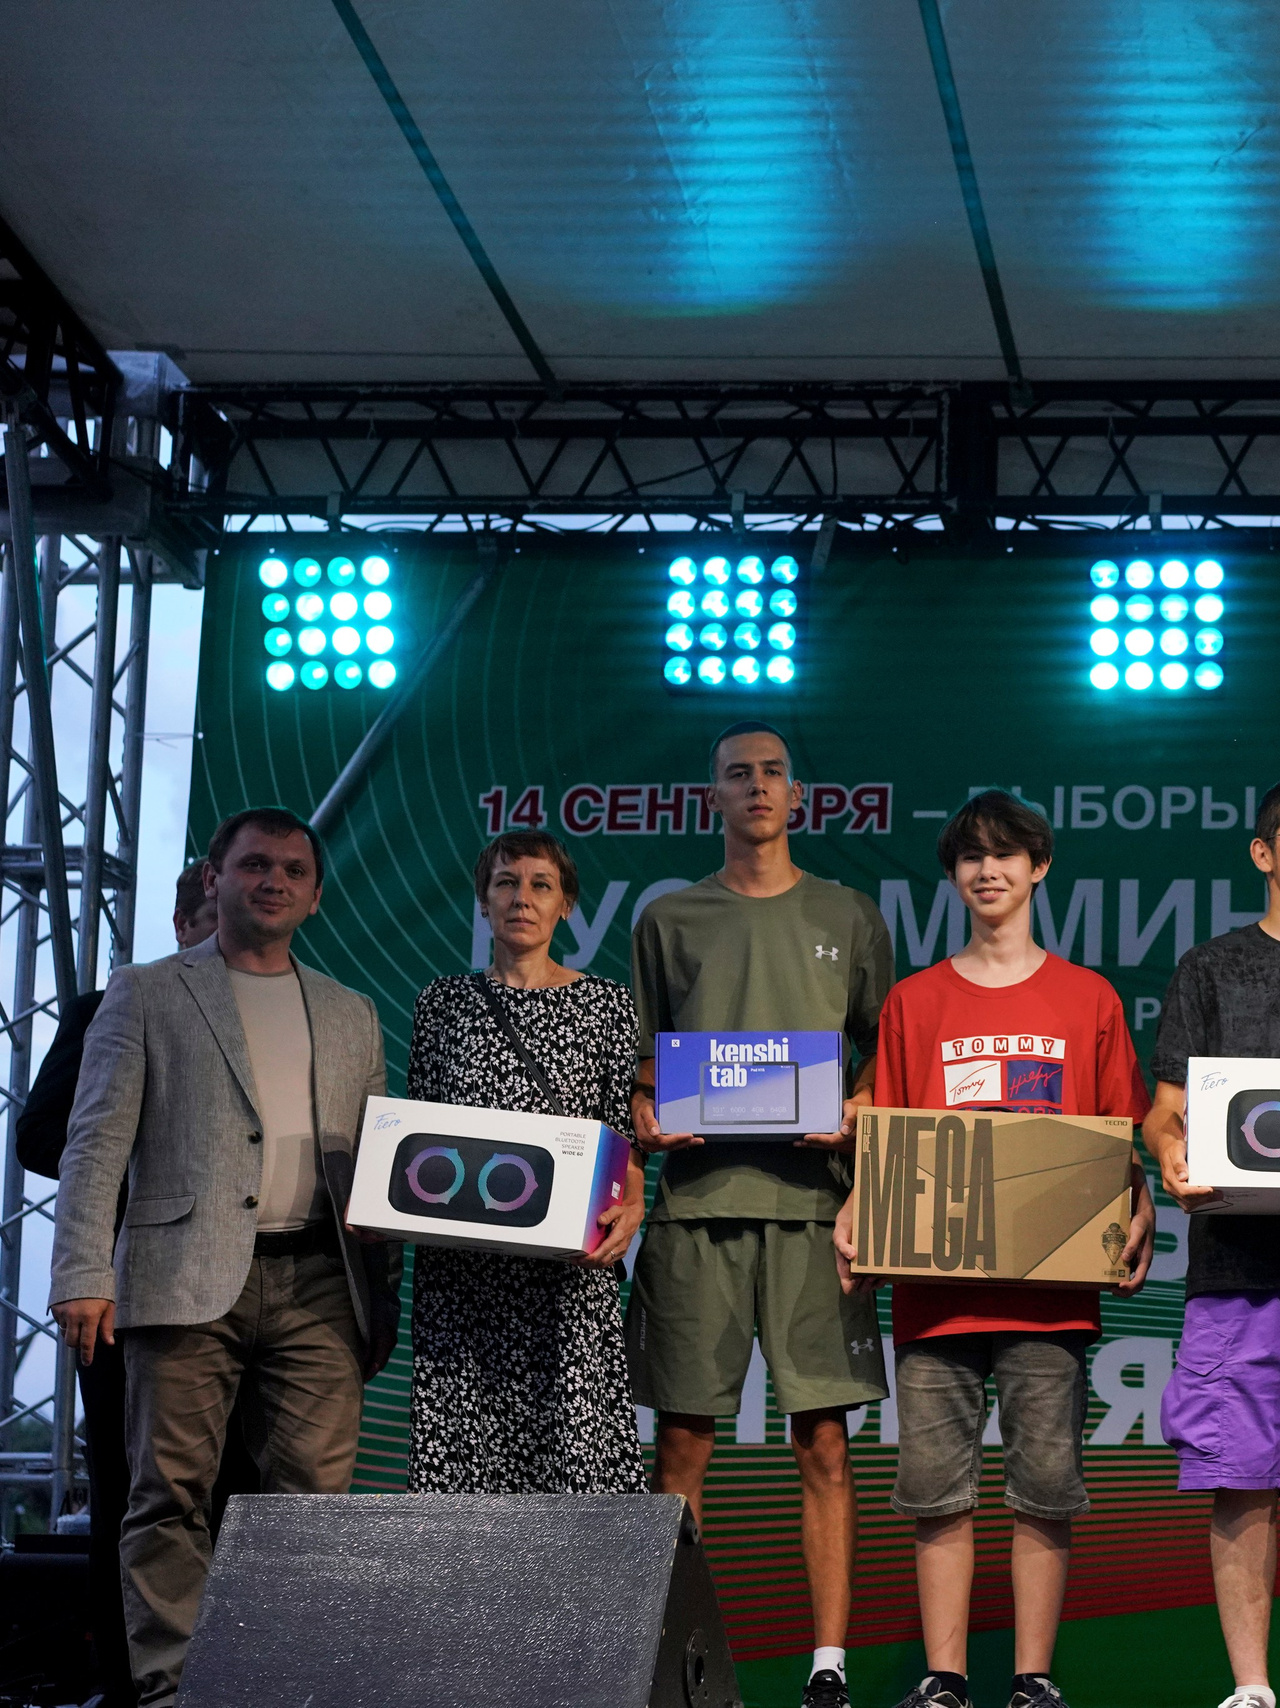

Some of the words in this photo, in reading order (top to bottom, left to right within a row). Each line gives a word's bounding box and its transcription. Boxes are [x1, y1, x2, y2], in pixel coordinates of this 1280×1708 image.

[479, 784, 547, 836] 14
[710, 1037, 789, 1063] kenshi
[952, 1036, 1055, 1057] TOMMY
[709, 1063, 748, 1088] tab
[1200, 1071, 1229, 1092] Fiero
[373, 1112, 402, 1131] Fiero
[554, 1136, 586, 1145] BLUETOOTH
[560, 1131, 586, 1139] PORTABLE
[561, 1143, 585, 1151] SPEAKER
[857, 1114, 997, 1272] MEGA
